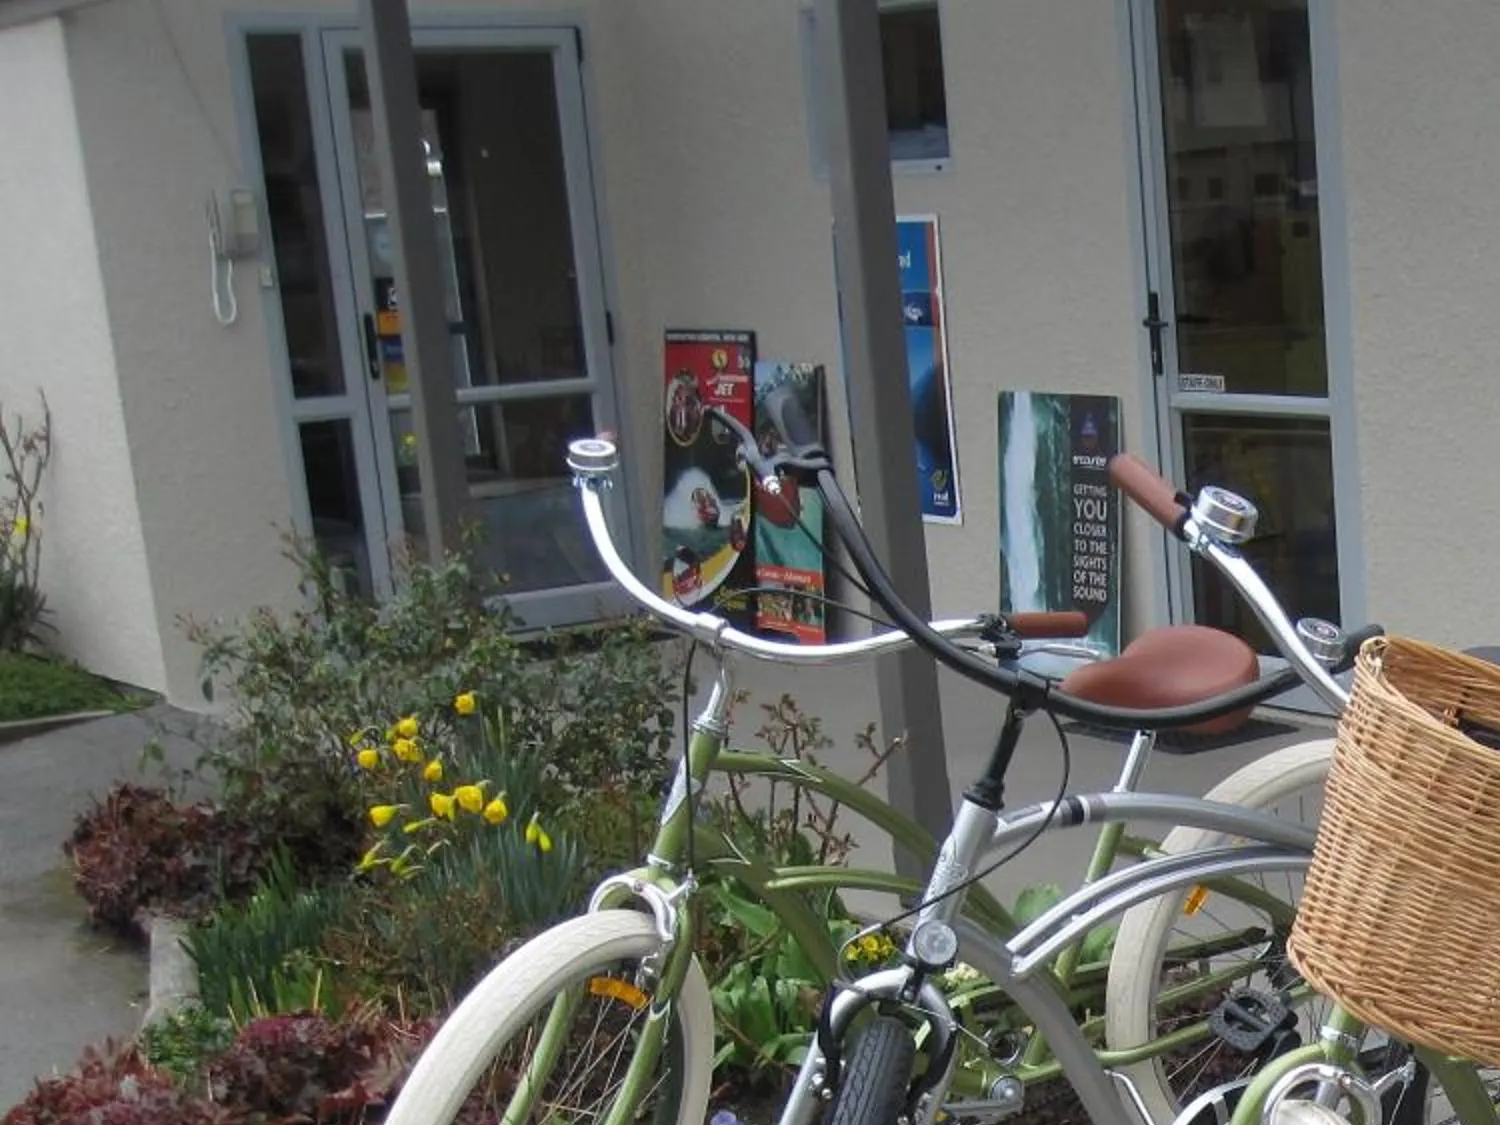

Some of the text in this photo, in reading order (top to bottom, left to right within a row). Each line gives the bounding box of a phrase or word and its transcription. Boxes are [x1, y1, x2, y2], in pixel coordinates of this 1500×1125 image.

[1073, 498, 1107, 521] YOU
[1073, 523, 1107, 537] CLOSER
[1074, 539, 1107, 554] TO THE
[1073, 555, 1107, 571] SIGHTS
[1073, 571, 1107, 586] OF THE
[1073, 586, 1107, 602] SOUND
